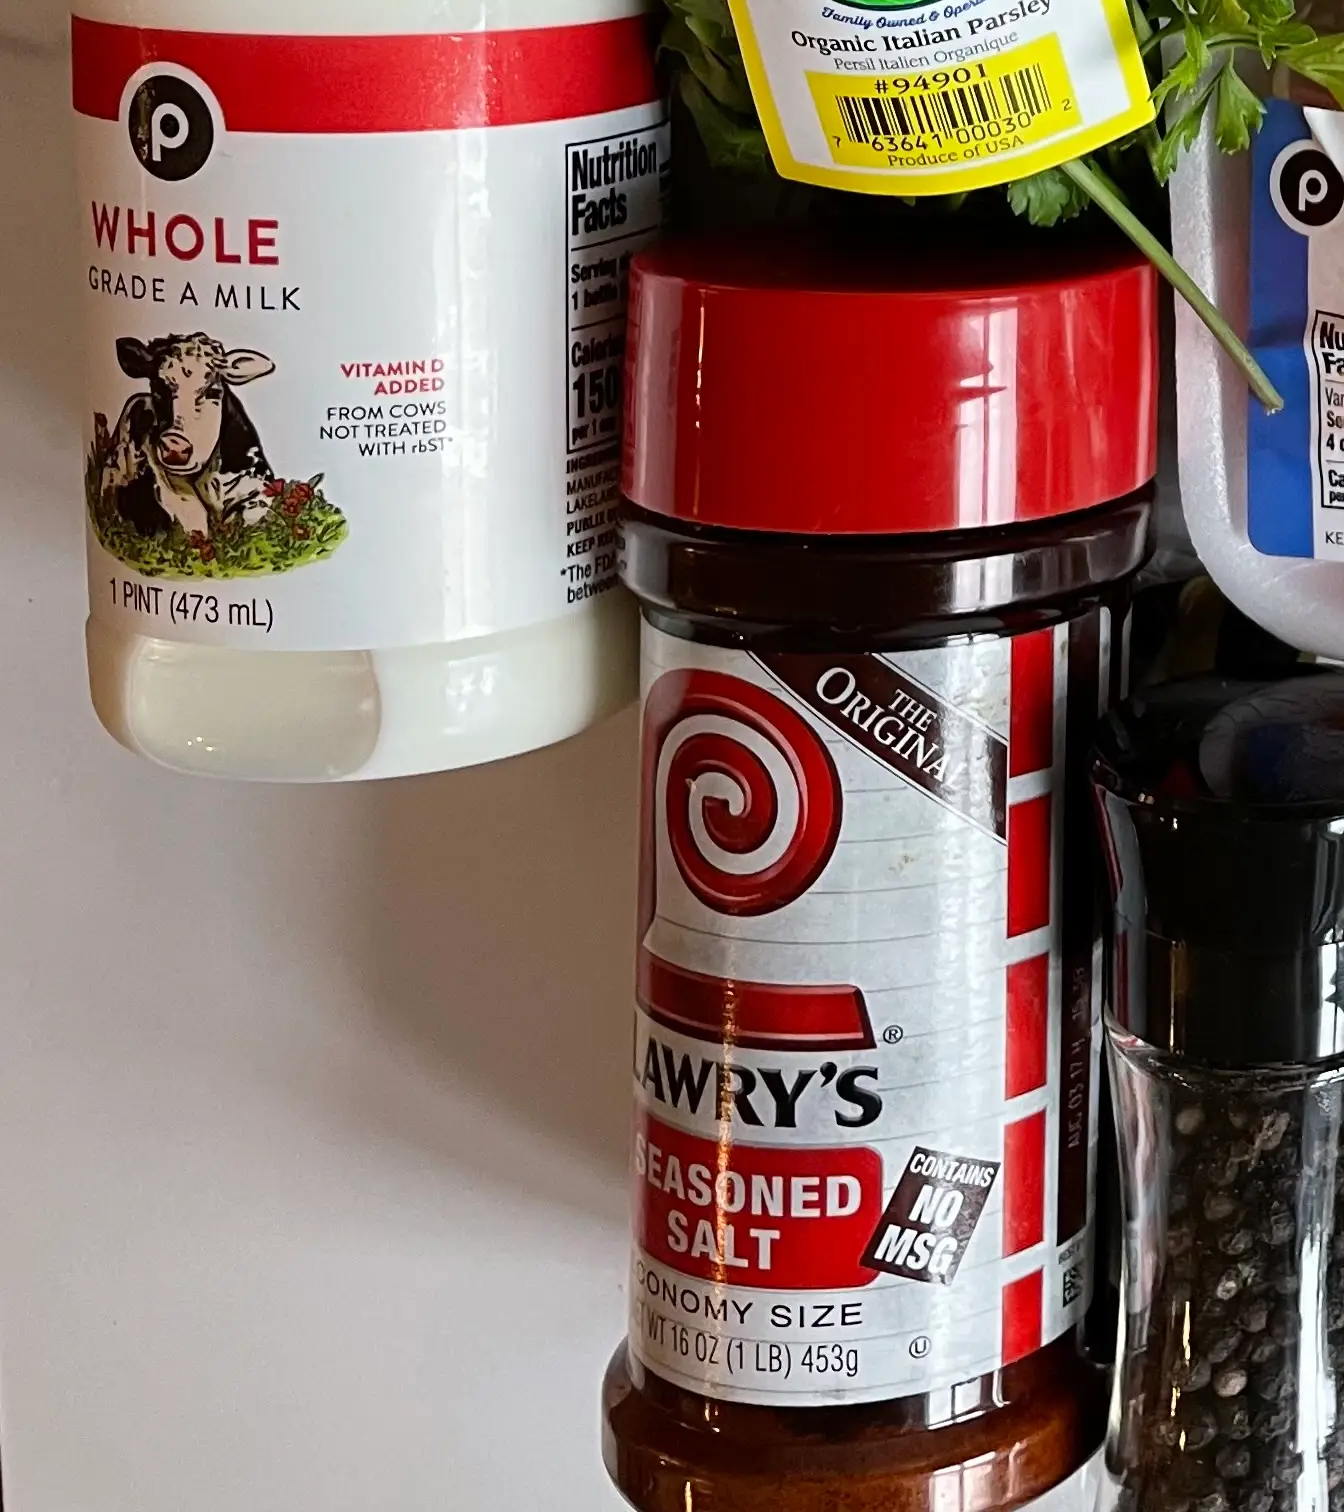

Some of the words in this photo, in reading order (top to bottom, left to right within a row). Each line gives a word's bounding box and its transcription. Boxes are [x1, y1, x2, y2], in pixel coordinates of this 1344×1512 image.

[820, 6, 874, 30] Family
[875, 12, 927, 29] Owned
[790, 29, 878, 57] Organic
[880, 25, 963, 52] Italian
[833, 55, 876, 71] Persil
[933, 28, 1020, 65] Organique
[873, 62, 989, 95] #94901
[571, 137, 658, 192] Nutrition
[886, 150, 959, 168] Produce
[963, 144, 982, 158] of
[984, 134, 1026, 155] USA
[91, 199, 280, 266] WHOLE
[571, 186, 628, 236] Facts
[88, 265, 166, 303] GRADE
[179, 280, 199, 307] A
[214, 282, 301, 311] MILK
[340, 360, 426, 379] VITAMIN
[431, 358, 445, 373] D
[373, 377, 446, 396] ADDED
[319, 425, 360, 440] NOT
[363, 419, 447, 439] TREATED
[327, 405, 384, 421] FROM
[388, 400, 447, 419] COWS
[358, 440, 406, 457] WITH
[109, 577, 118, 606] 1
[122, 580, 164, 616] PINT
[169, 590, 220, 625] (473
[228, 598, 274, 634] mL)
[888, 688, 938, 733] THE
[633, 1132, 863, 1219] SEASONED
[909, 1152, 996, 1188] CONTAINS
[907, 1183, 965, 1229] NO
[666, 1208, 782, 1271] SALT
[873, 1223, 959, 1276] MSG
[769, 1301, 864, 1329] SIZE
[670, 1324, 691, 1357] 16
[694, 1331, 720, 1366] OZ
[800, 1342, 860, 1379] 453g
